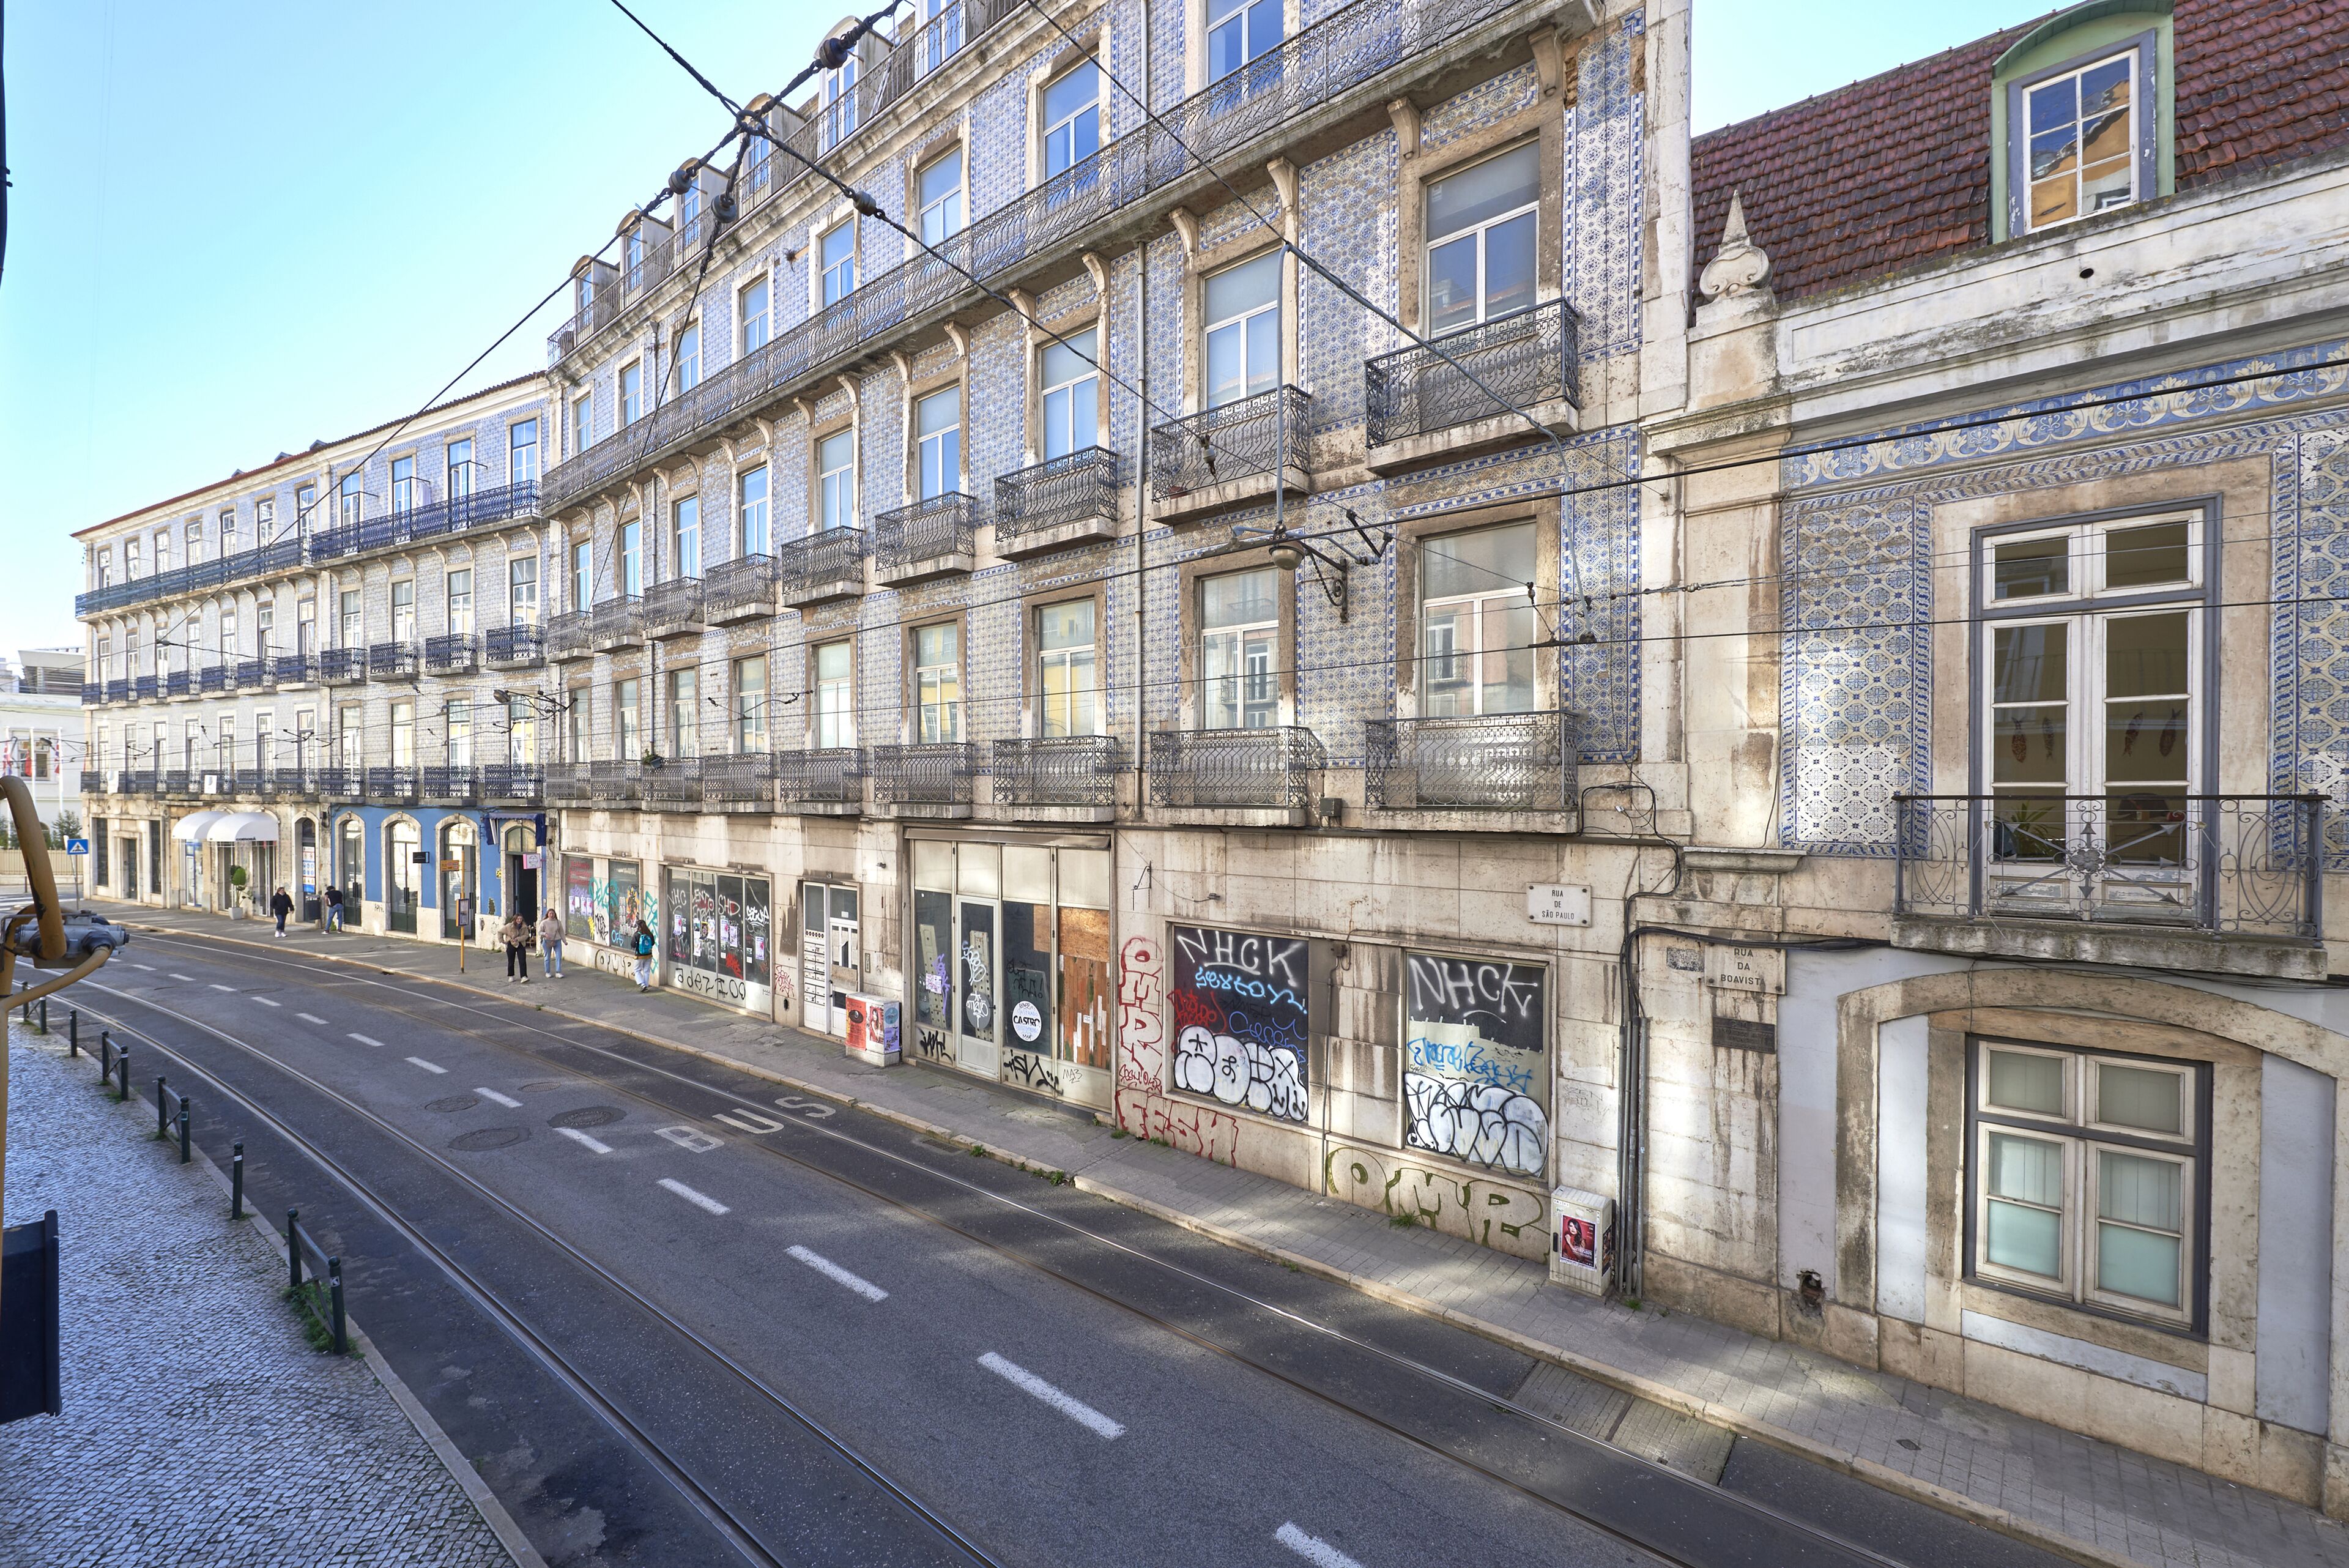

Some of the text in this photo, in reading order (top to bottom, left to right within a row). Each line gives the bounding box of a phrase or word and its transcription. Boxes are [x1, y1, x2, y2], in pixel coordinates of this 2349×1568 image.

[1542, 910, 1553, 918] SÃO
[1176, 929, 1305, 987] NHCK
[1734, 948, 1754, 957] RUA
[1737, 962, 1750, 971] DA
[1408, 956, 1538, 1017] NHCK
[1720, 974, 1766, 987] BOAVIST
[653, 1096, 836, 1154] BUS
